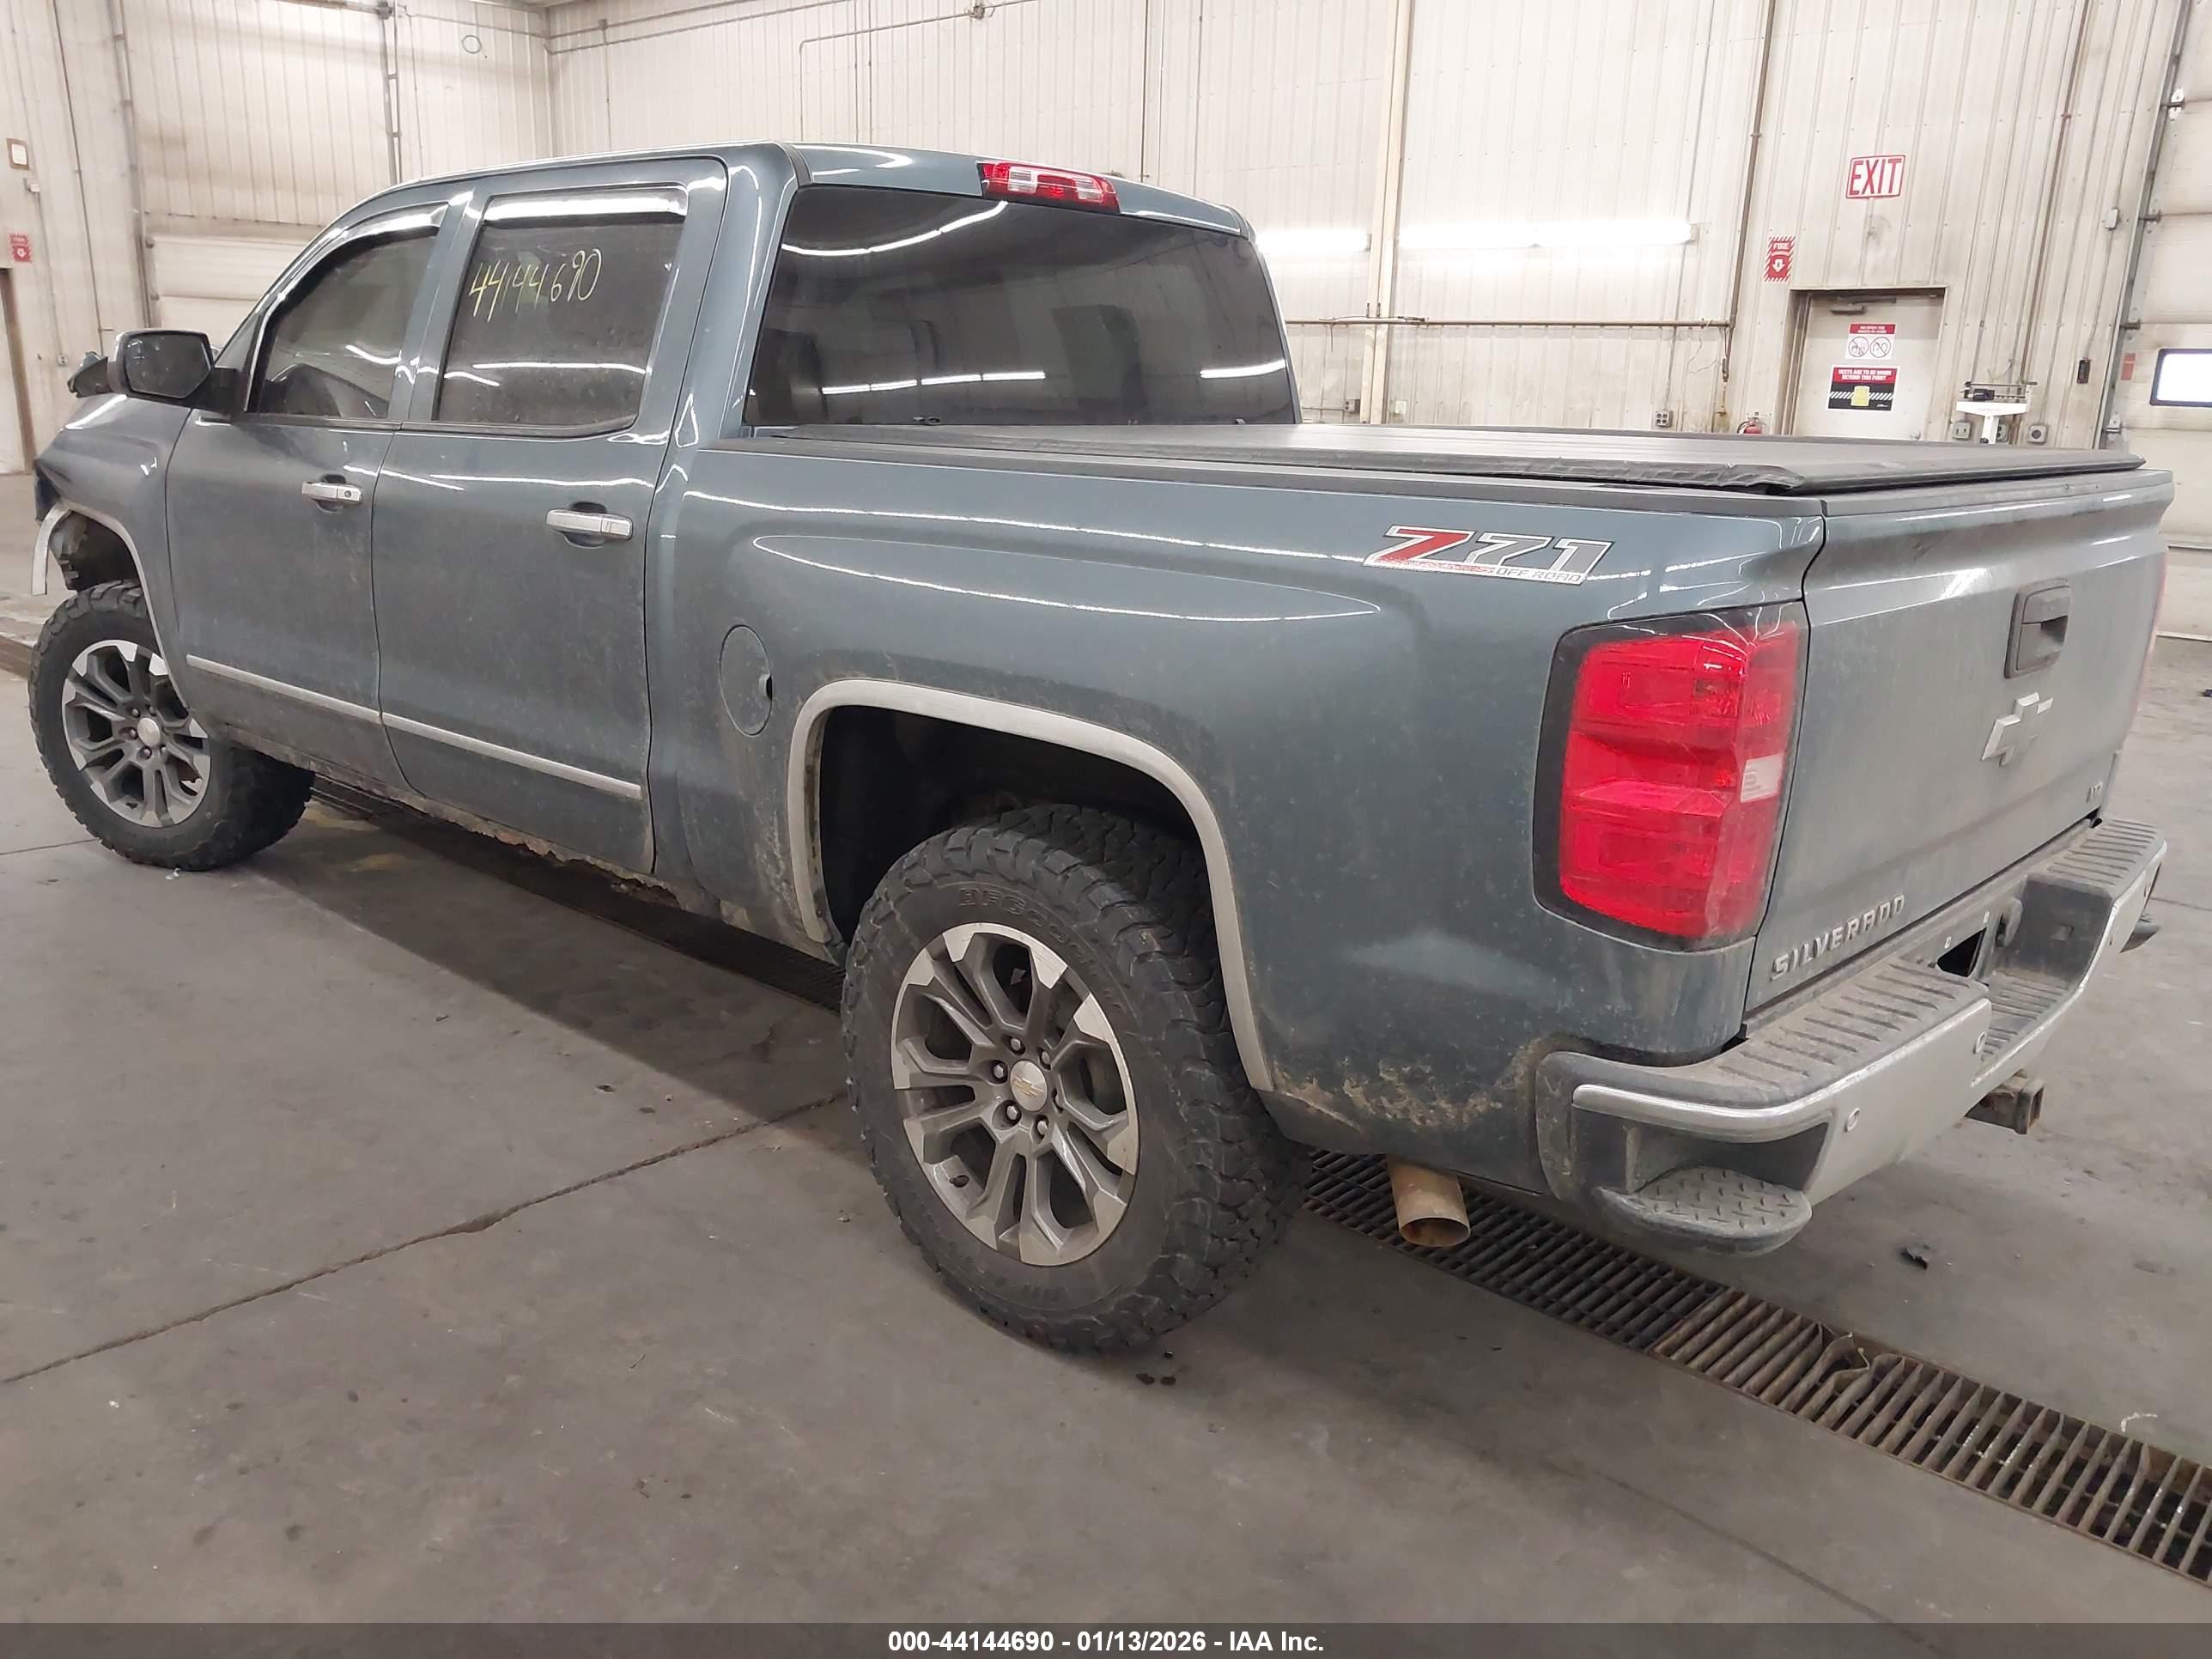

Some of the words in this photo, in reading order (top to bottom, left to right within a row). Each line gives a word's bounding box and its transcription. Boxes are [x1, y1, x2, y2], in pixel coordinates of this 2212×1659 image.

[1849, 158, 1902, 196] EXIT
[468, 248, 602, 323] 44144690
[1363, 525, 1614, 577] Z71
[1533, 570, 1582, 582] ROAD
[1770, 894, 1905, 981] SILVERADO
